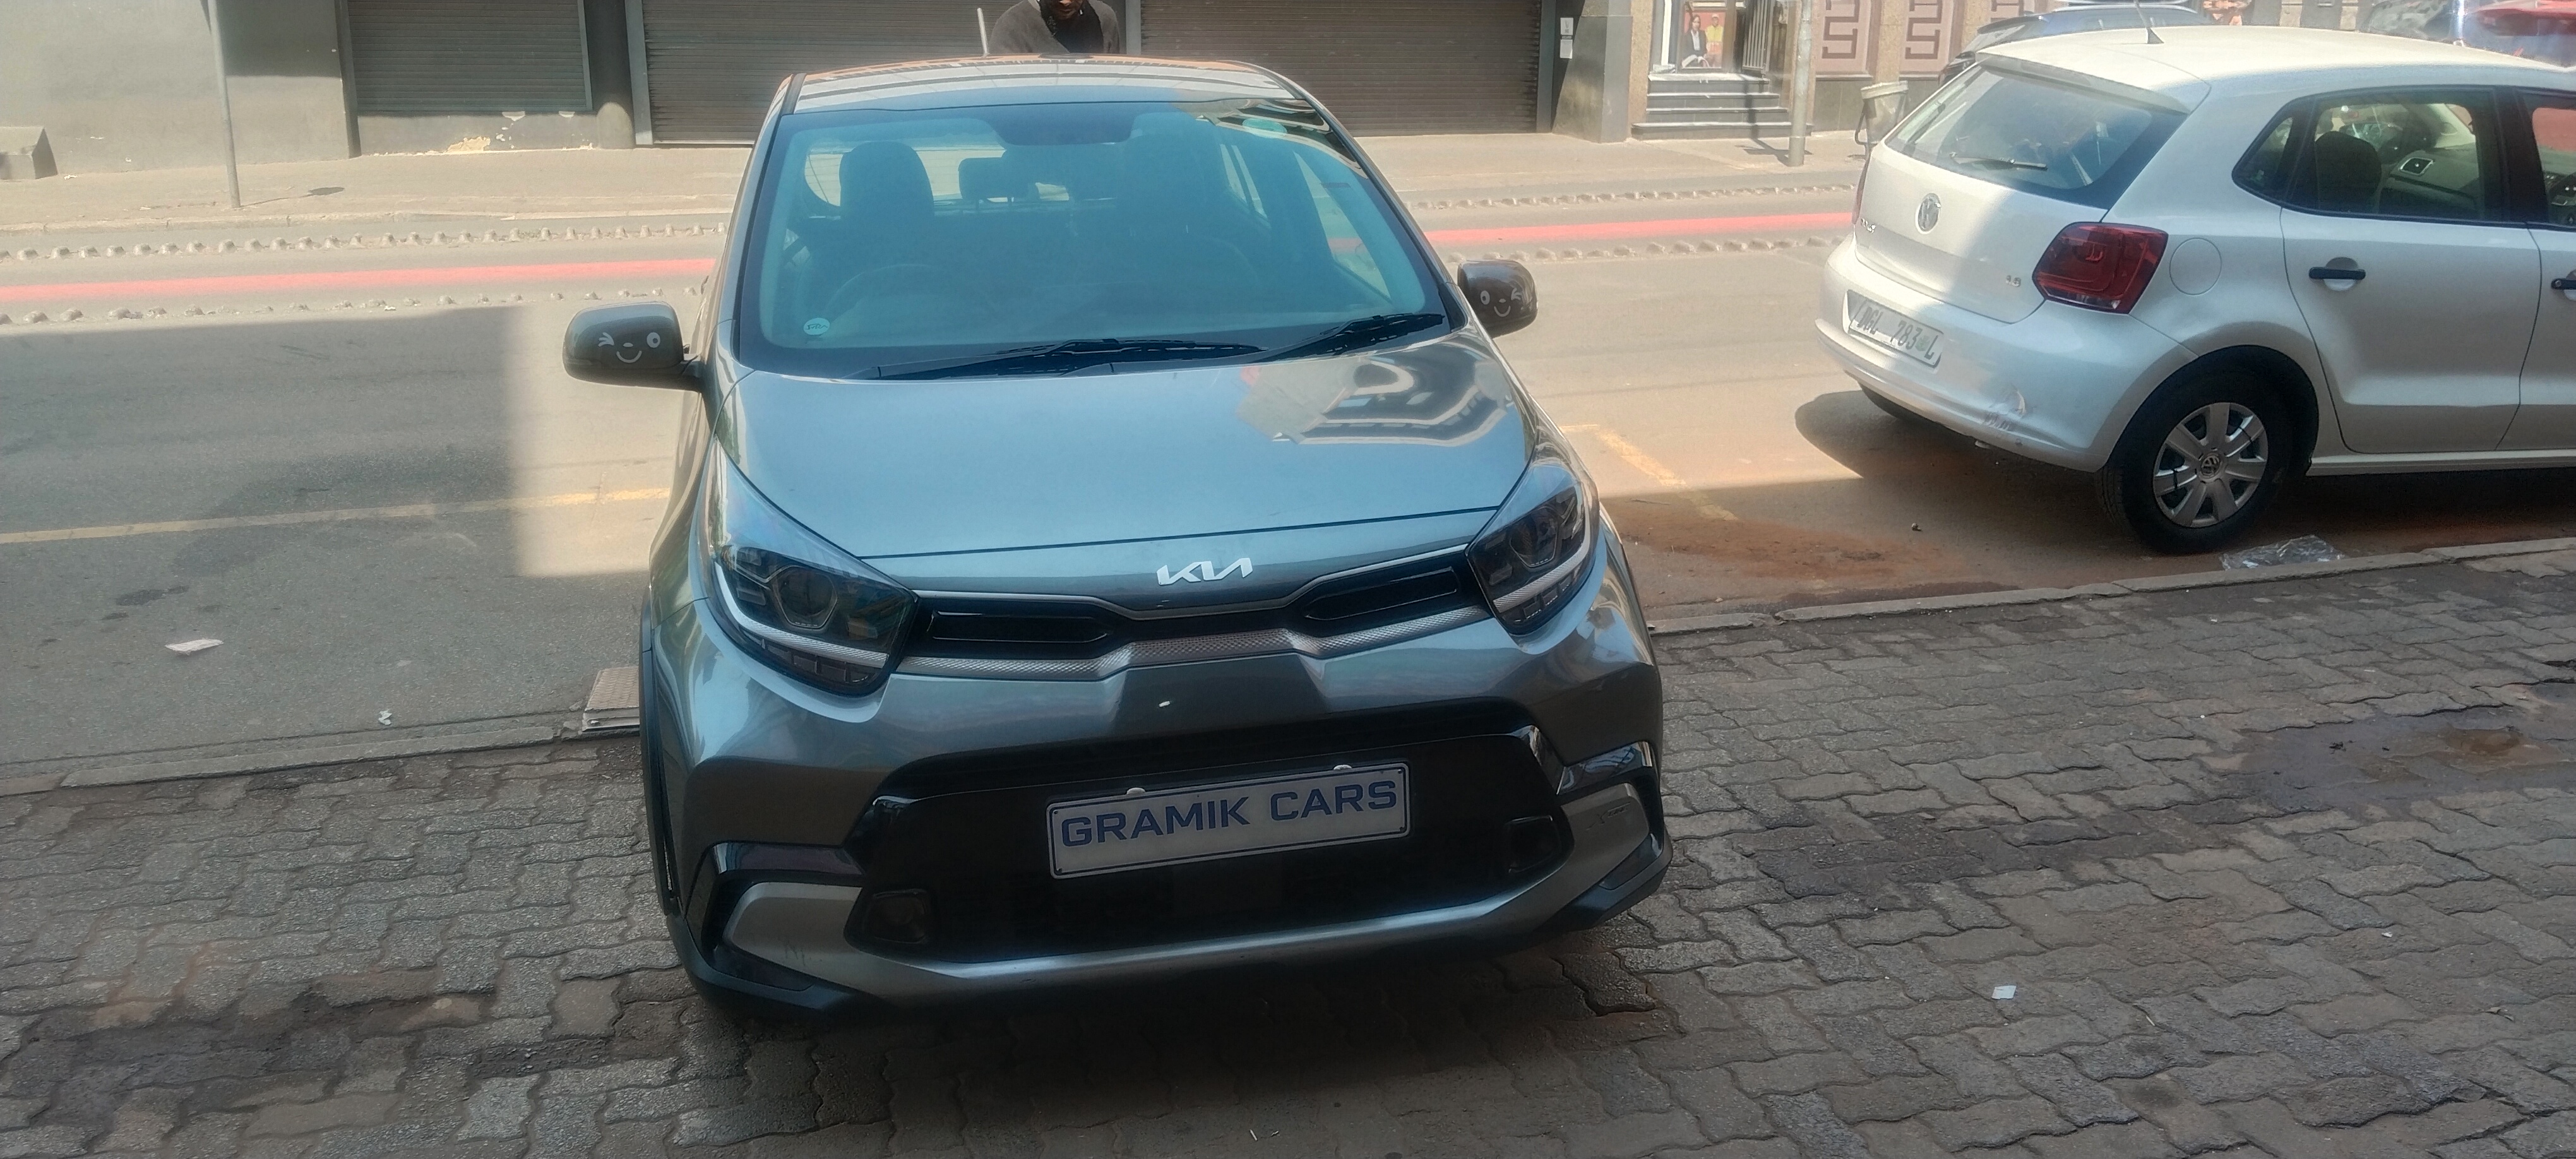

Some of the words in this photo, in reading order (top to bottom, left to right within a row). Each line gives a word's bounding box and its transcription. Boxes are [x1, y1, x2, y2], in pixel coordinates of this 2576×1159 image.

[1890, 320, 1923, 350] 783
[1924, 335, 1939, 360] L
[1061, 796, 1250, 847] GRAMIK
[1270, 780, 1397, 821] CARS
